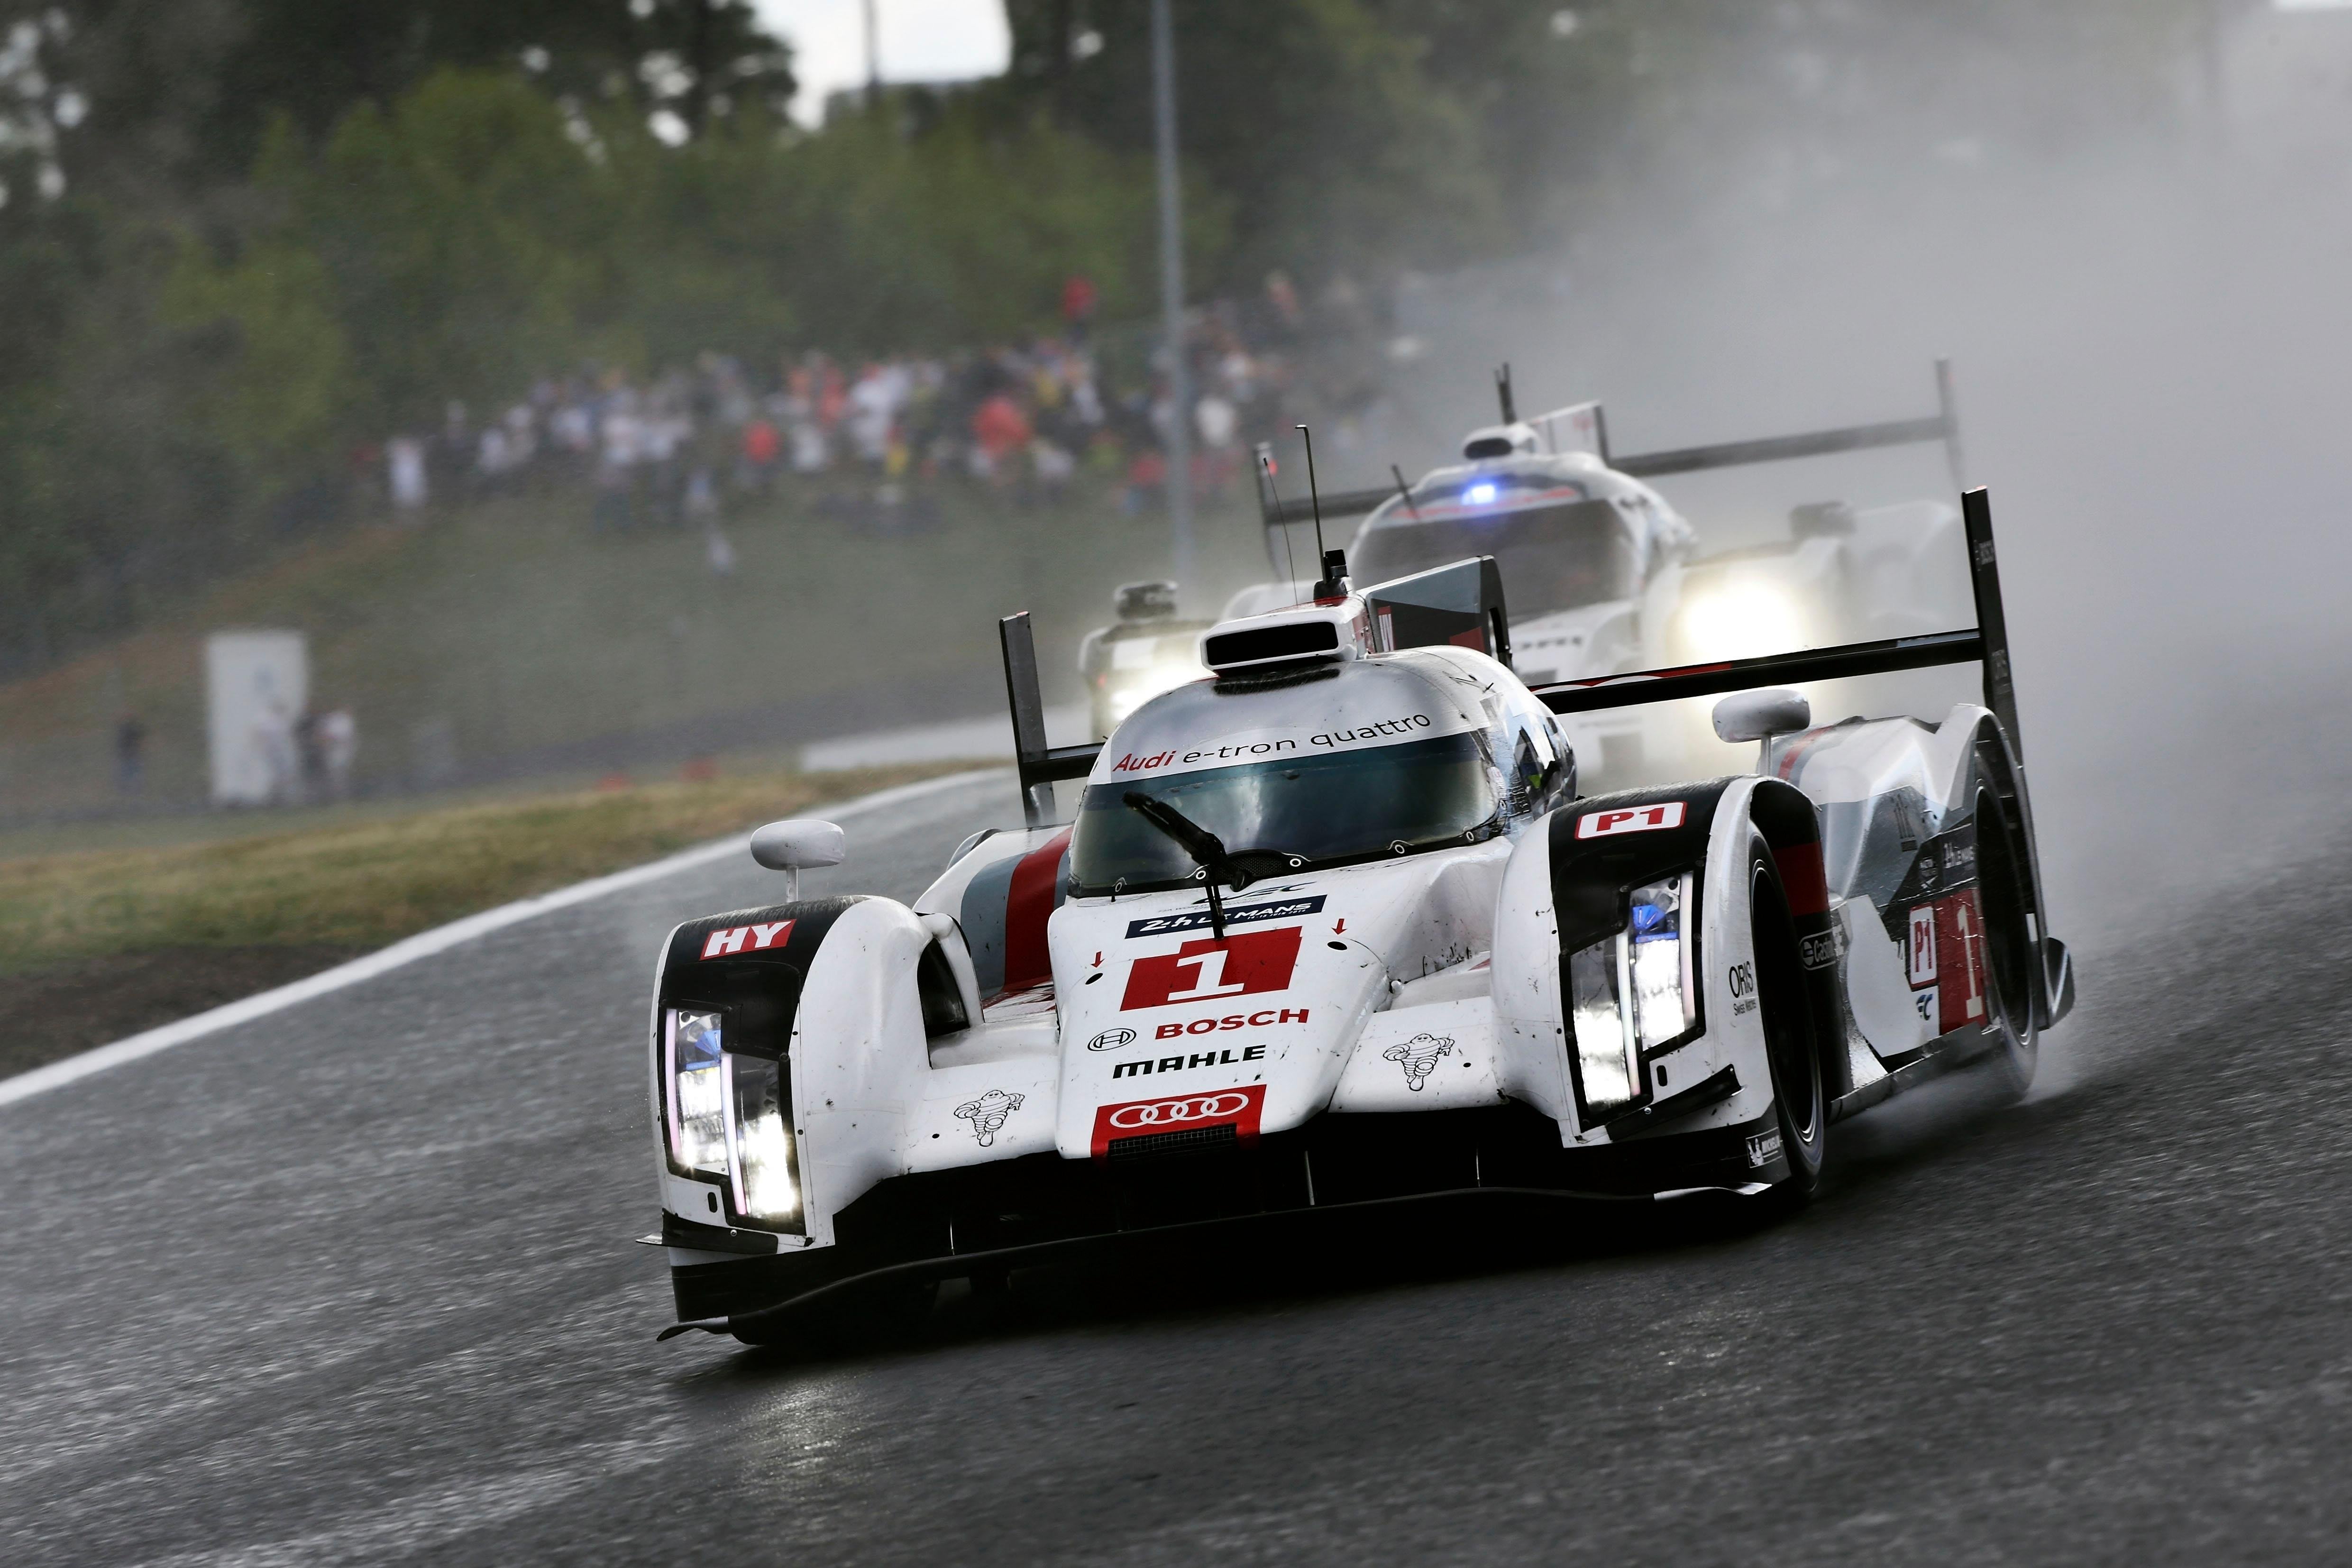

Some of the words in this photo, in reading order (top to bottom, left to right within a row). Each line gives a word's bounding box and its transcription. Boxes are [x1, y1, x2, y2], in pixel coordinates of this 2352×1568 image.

[1113, 751, 1176, 772] Audi
[1183, 738, 1296, 763] e-tron
[1310, 714, 1431, 747] quattro
[1596, 807, 1665, 832] P1
[1235, 903, 1312, 918] MANS
[704, 921, 792, 957] HY
[1914, 918, 1932, 972] P1
[1167, 950, 1245, 1001] 1
[1729, 961, 1753, 999] ORIS
[1957, 904, 1984, 1019] 1
[1155, 1009, 1309, 1040] BOSCH
[1113, 1045, 1266, 1079] MAHLE
